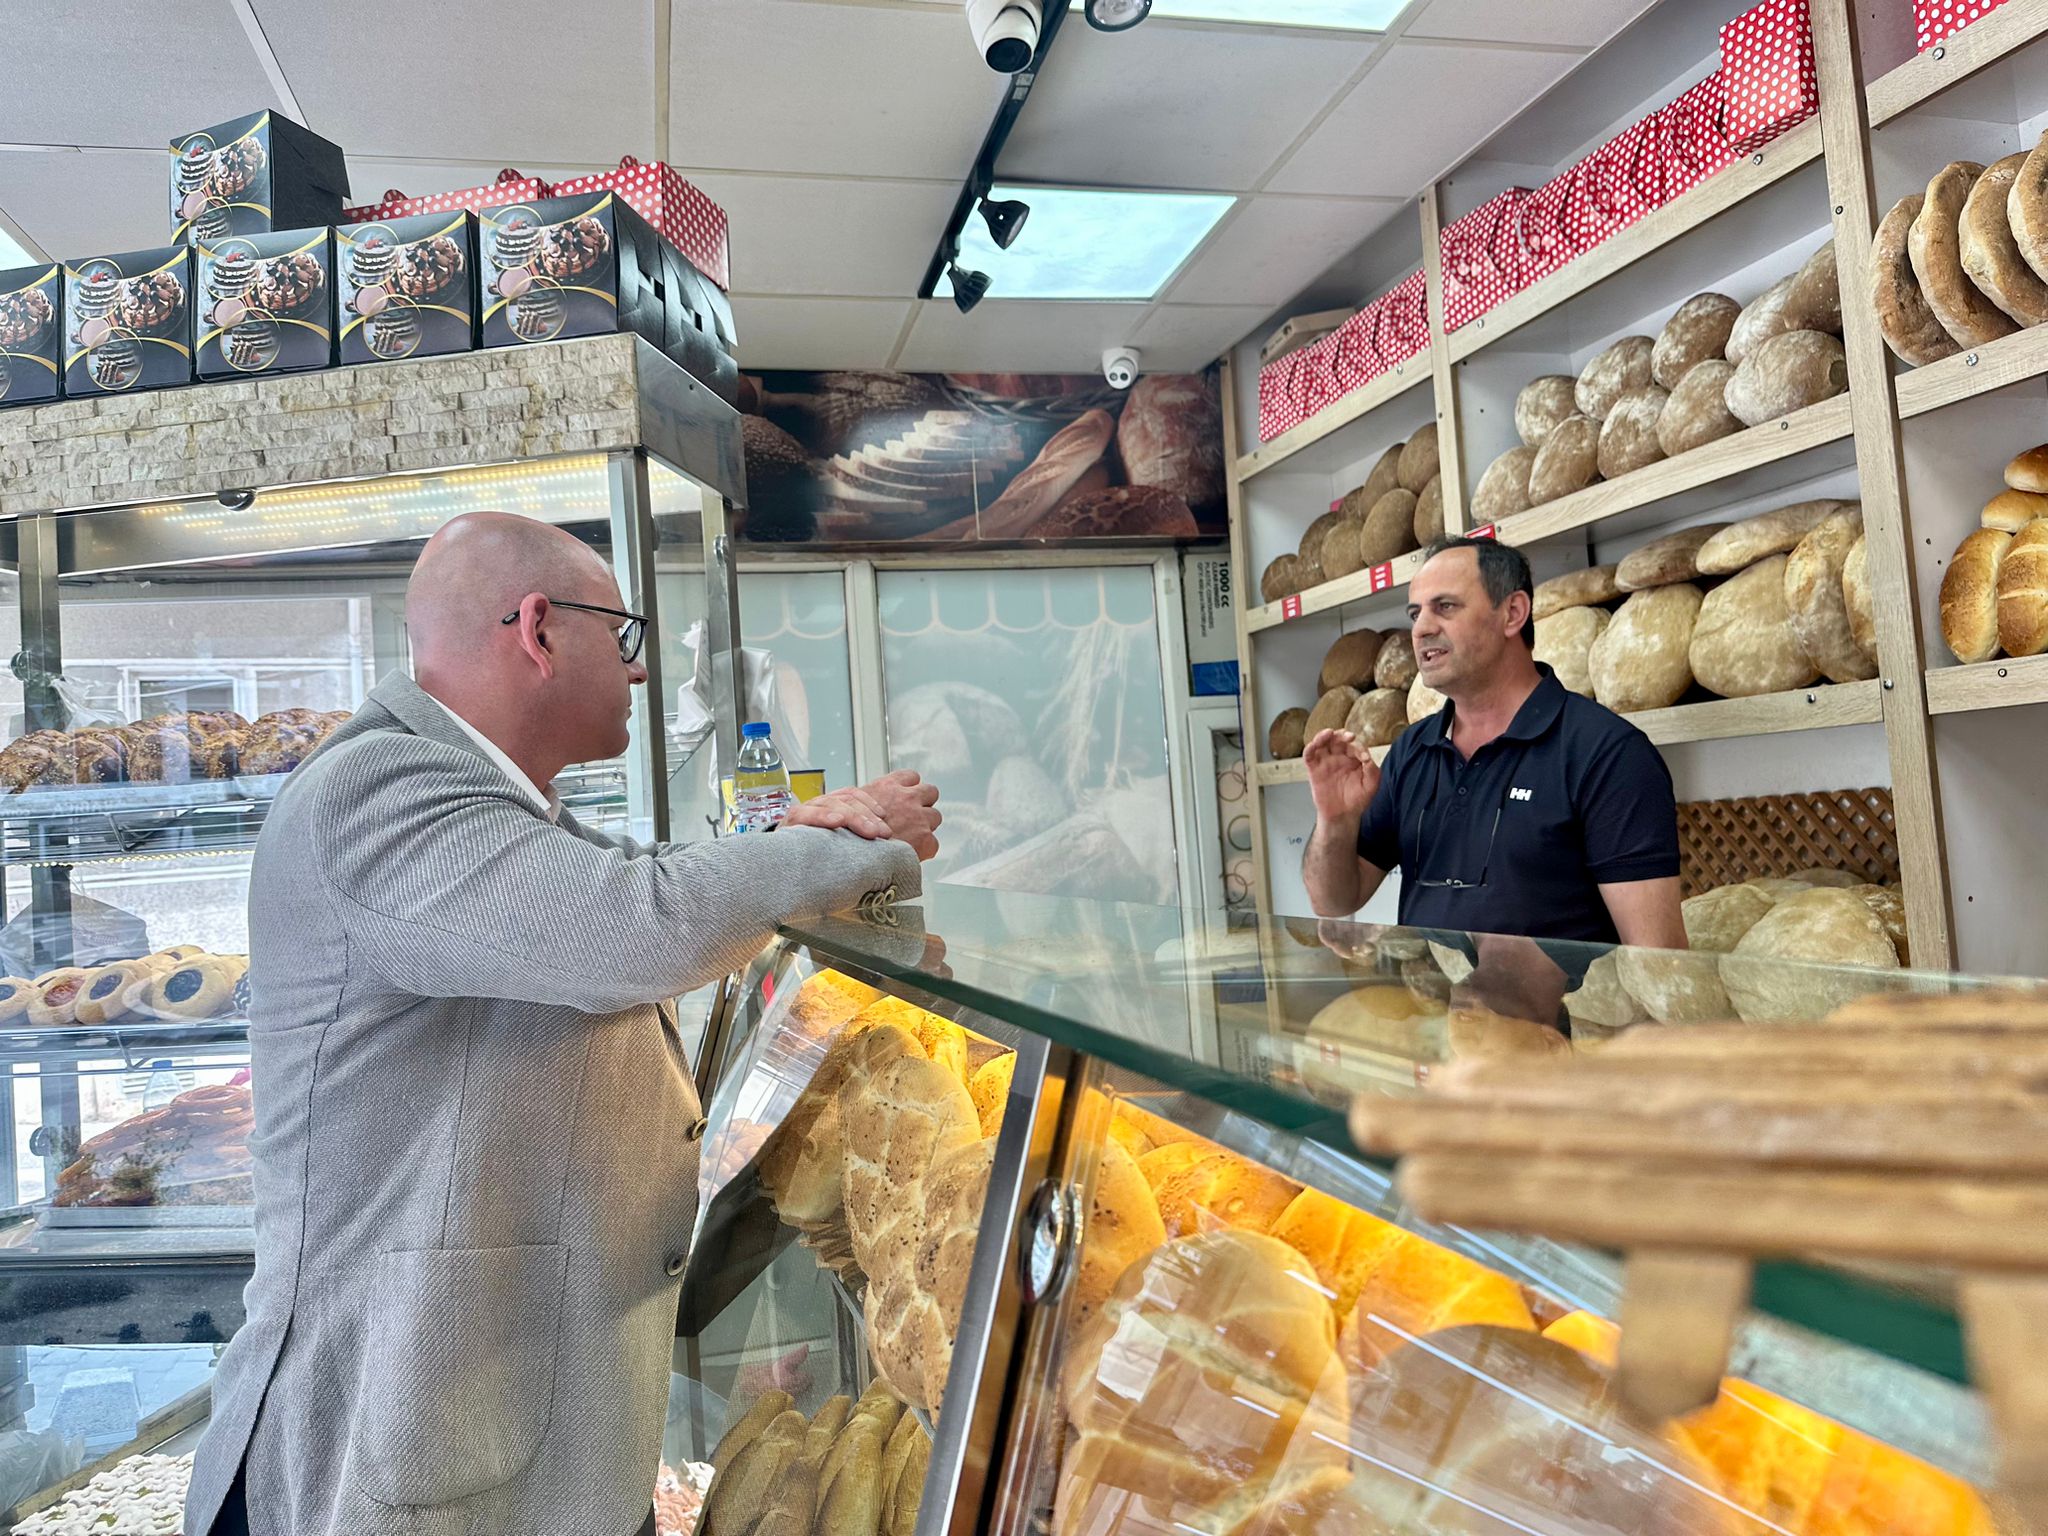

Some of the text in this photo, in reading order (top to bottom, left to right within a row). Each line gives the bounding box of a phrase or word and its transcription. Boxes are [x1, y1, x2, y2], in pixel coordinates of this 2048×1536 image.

[1219, 561, 1230, 608] 1000 cc
[1509, 787, 1532, 801] HH
